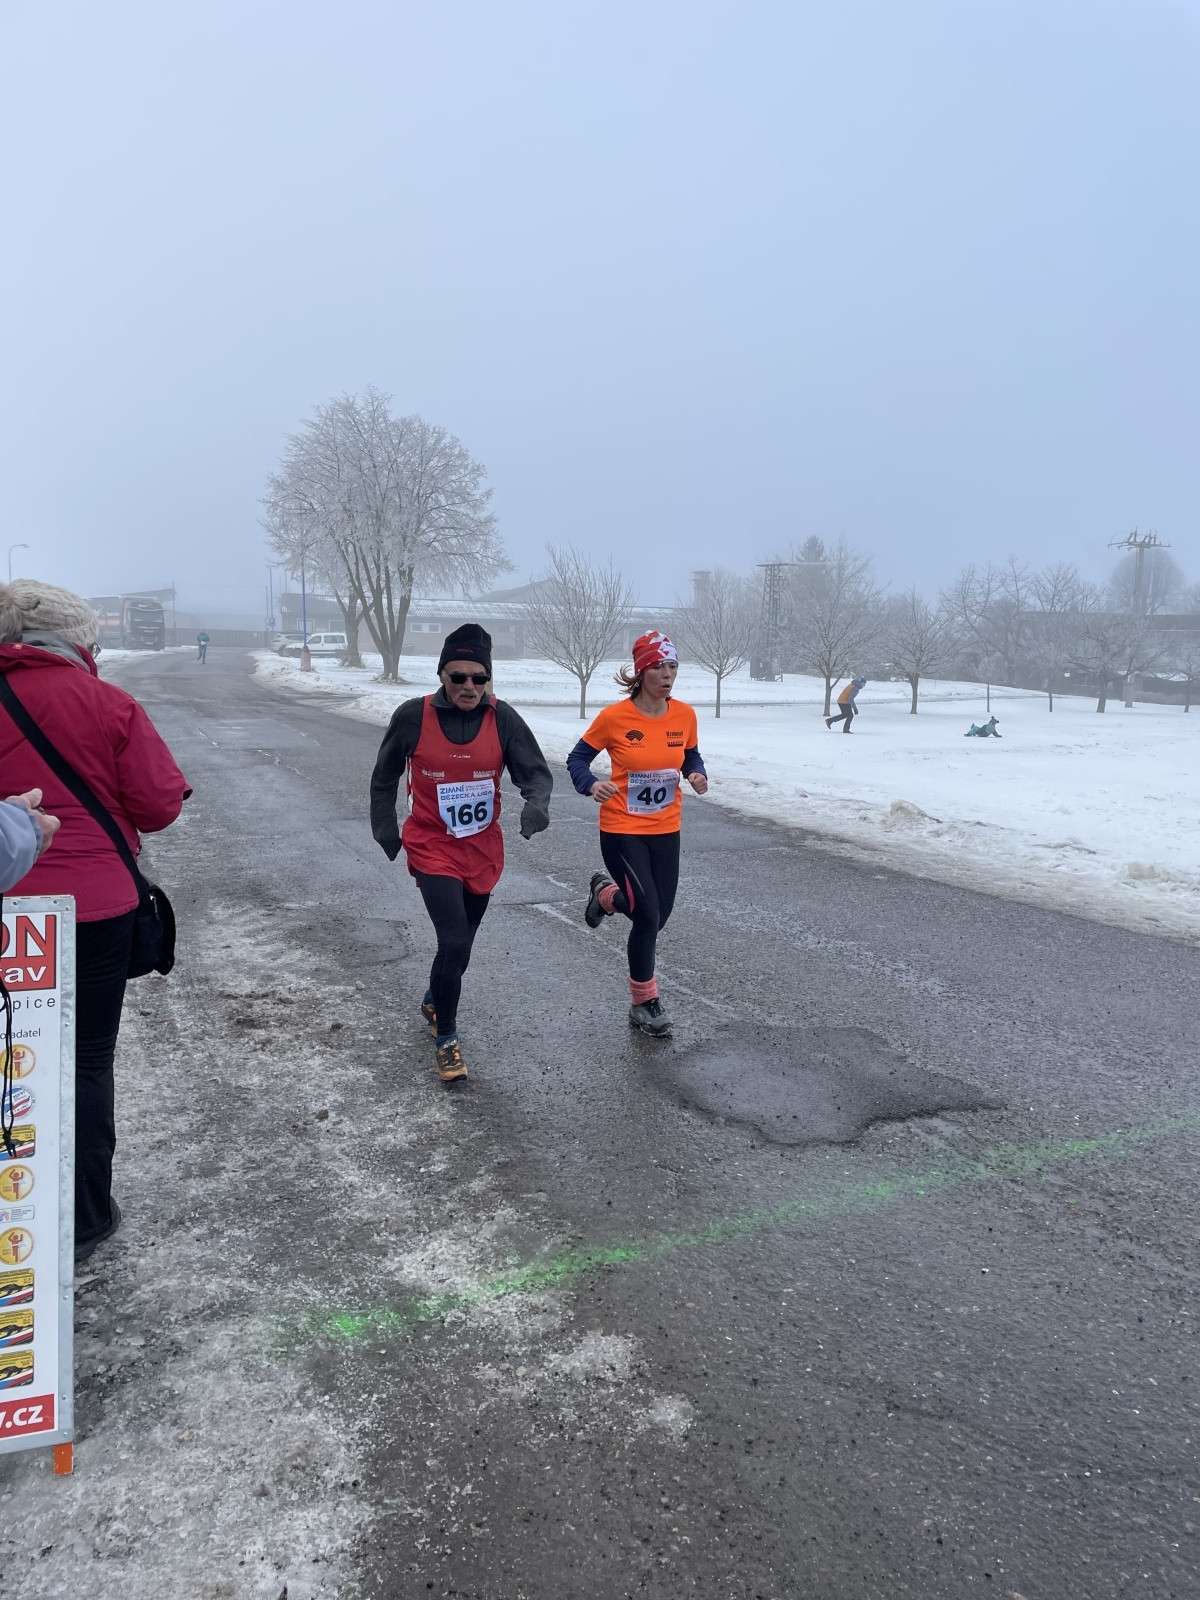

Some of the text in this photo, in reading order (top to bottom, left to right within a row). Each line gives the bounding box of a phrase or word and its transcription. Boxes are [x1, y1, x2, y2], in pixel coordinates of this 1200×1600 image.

[440, 785, 465, 794] ZIMNÍ
[637, 787, 667, 805] 40
[446, 801, 488, 827] 166
[0, 965, 47, 984] av
